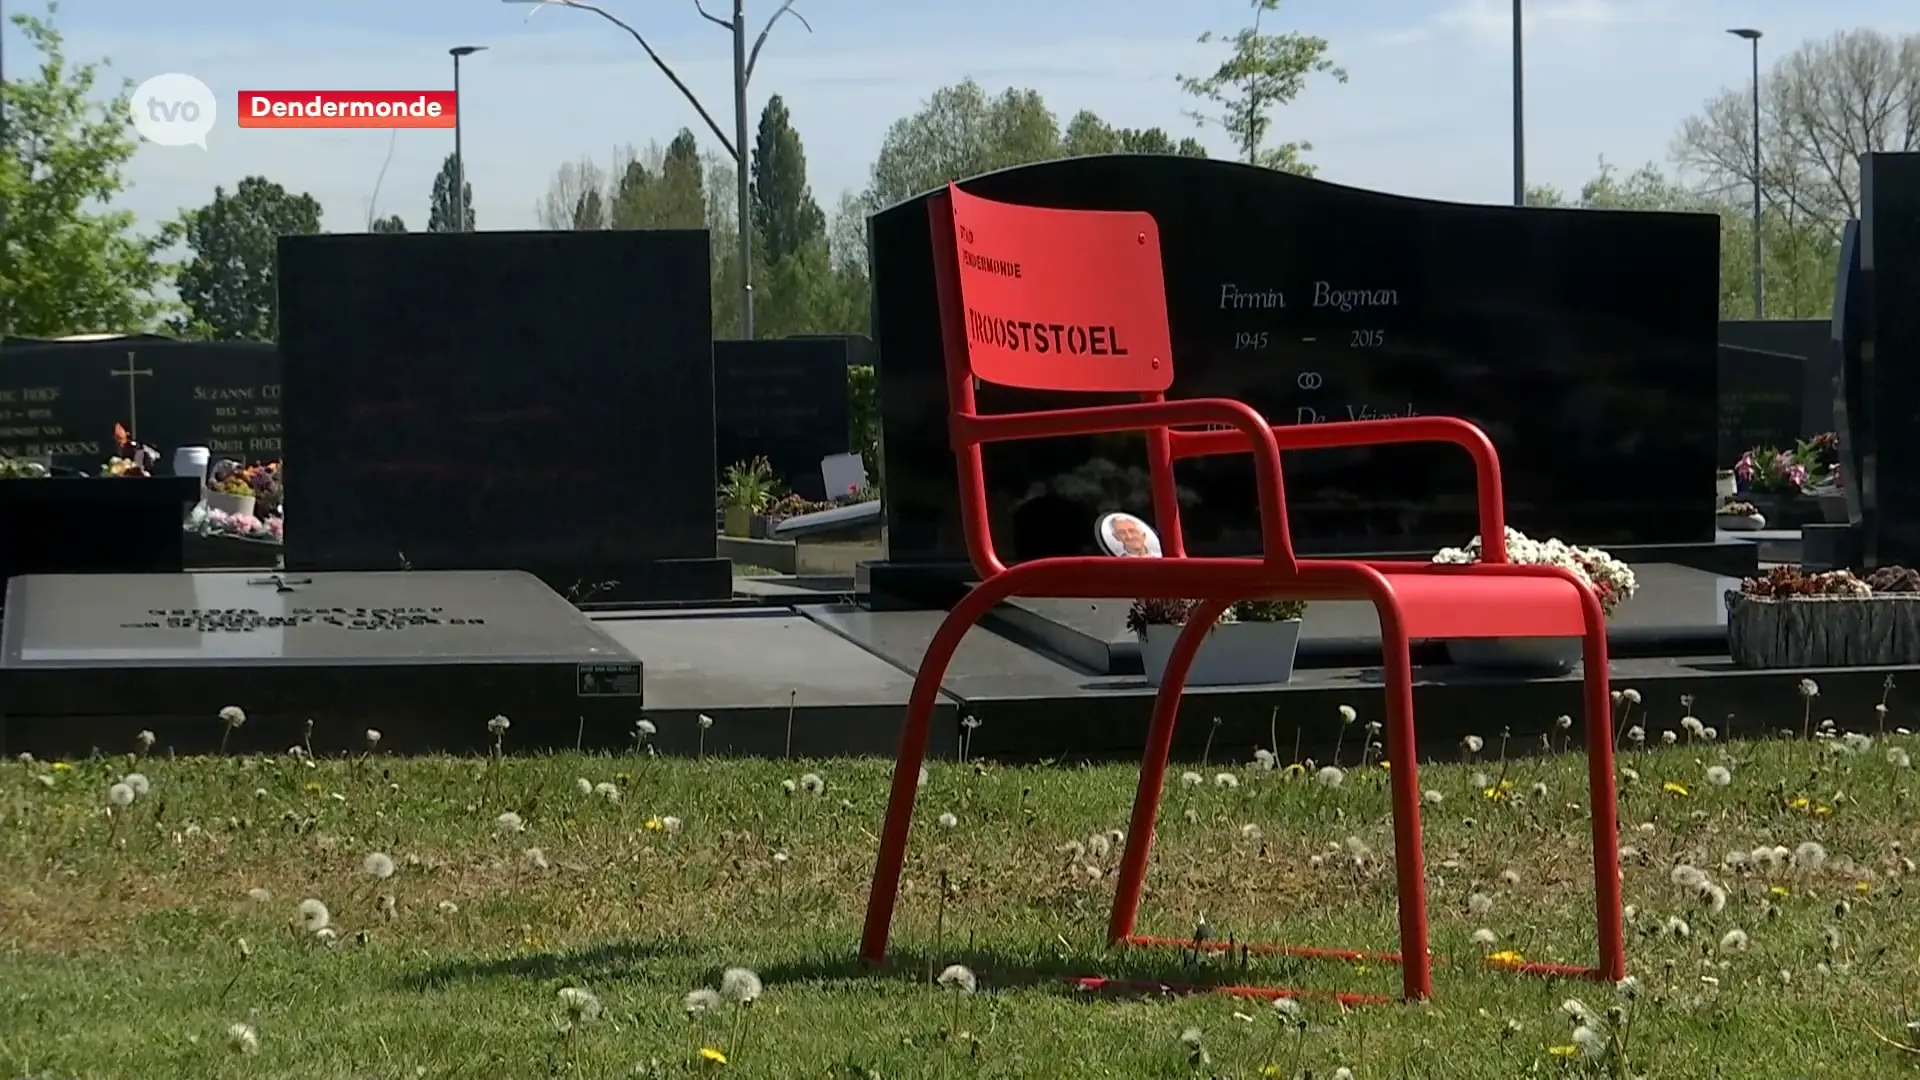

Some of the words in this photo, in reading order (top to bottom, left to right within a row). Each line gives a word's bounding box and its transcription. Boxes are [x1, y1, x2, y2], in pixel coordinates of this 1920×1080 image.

[1218, 284, 1286, 309] Firmin
[1312, 281, 1399, 312] Bogman
[968, 307, 1129, 356] TROOSTSTOEL
[1235, 331, 1269, 350] 1945
[1350, 329, 1385, 348] 2015
